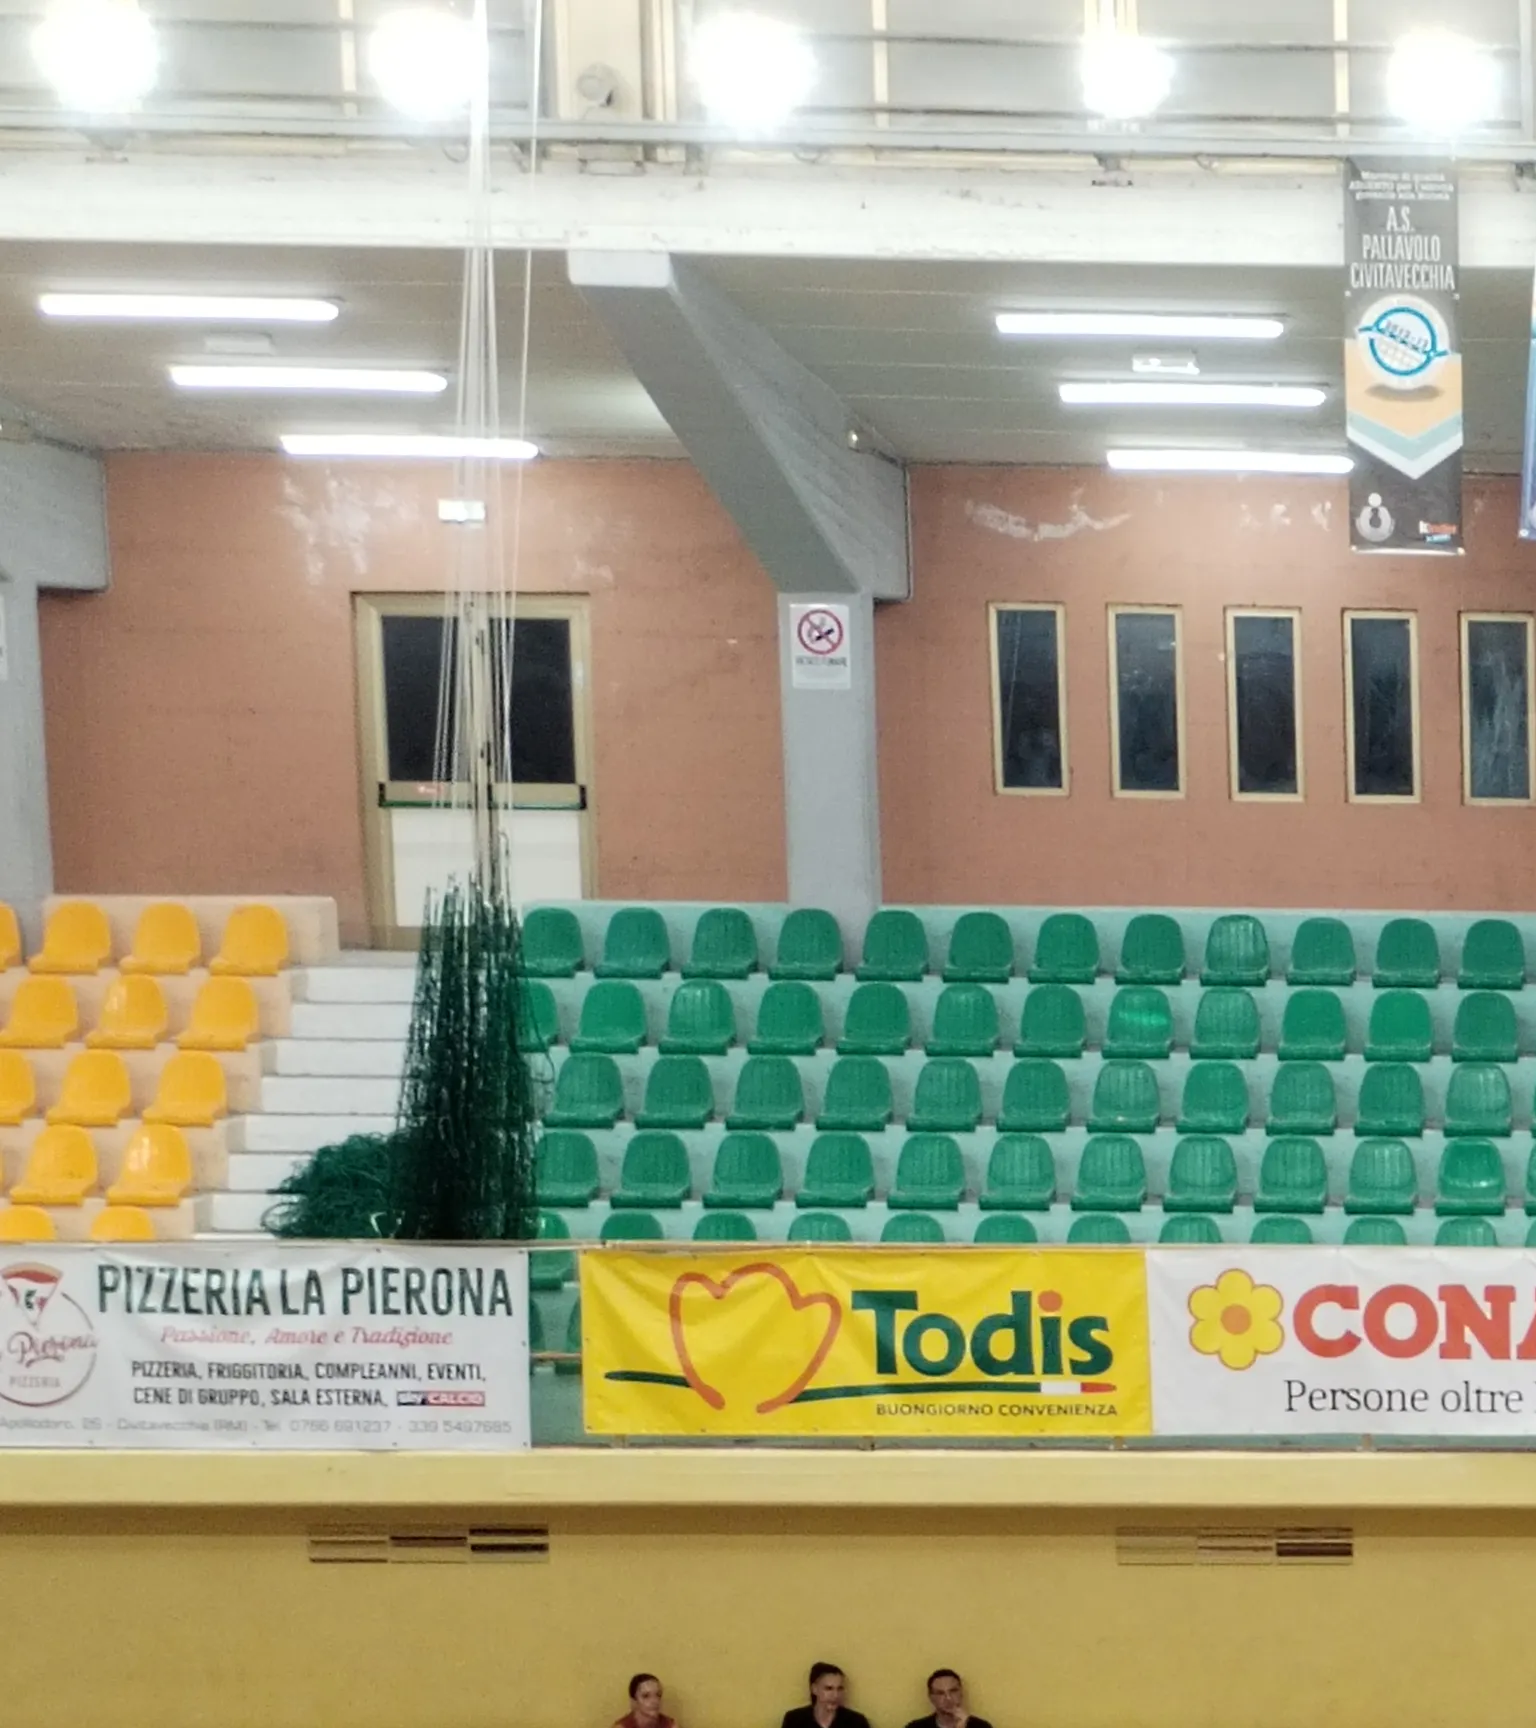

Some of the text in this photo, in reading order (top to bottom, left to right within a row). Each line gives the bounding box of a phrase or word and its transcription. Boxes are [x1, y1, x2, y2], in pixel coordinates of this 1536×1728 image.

[1386, 205, 1415, 232] A.S.
[1362, 233, 1442, 262] PALLAVOLO
[1350, 261, 1456, 291] CIVITAVECCHIA
[98, 1264, 514, 1318] PIZZERIA LA PIERONA
[265, 1327, 328, 1346] Amore
[352, 1326, 454, 1348] Tradizione
[850, 1290, 1114, 1378] Todis
[132, 1360, 487, 1383] PIZZERIA, FRIGGITORIA, COMPLEANNI, EVENTI,
[133, 1388, 172, 1405] CENE
[178, 1388, 195, 1405] DI
[198, 1388, 266, 1408] GRUPPO,
[270, 1389, 311, 1406] SALA
[316, 1389, 388, 1408] ESTERNA,
[876, 1403, 1118, 1417] BUONGIORNO CONVENIENZA
[1284, 1379, 1430, 1413] Persone
[1441, 1380, 1524, 1414] oltre
